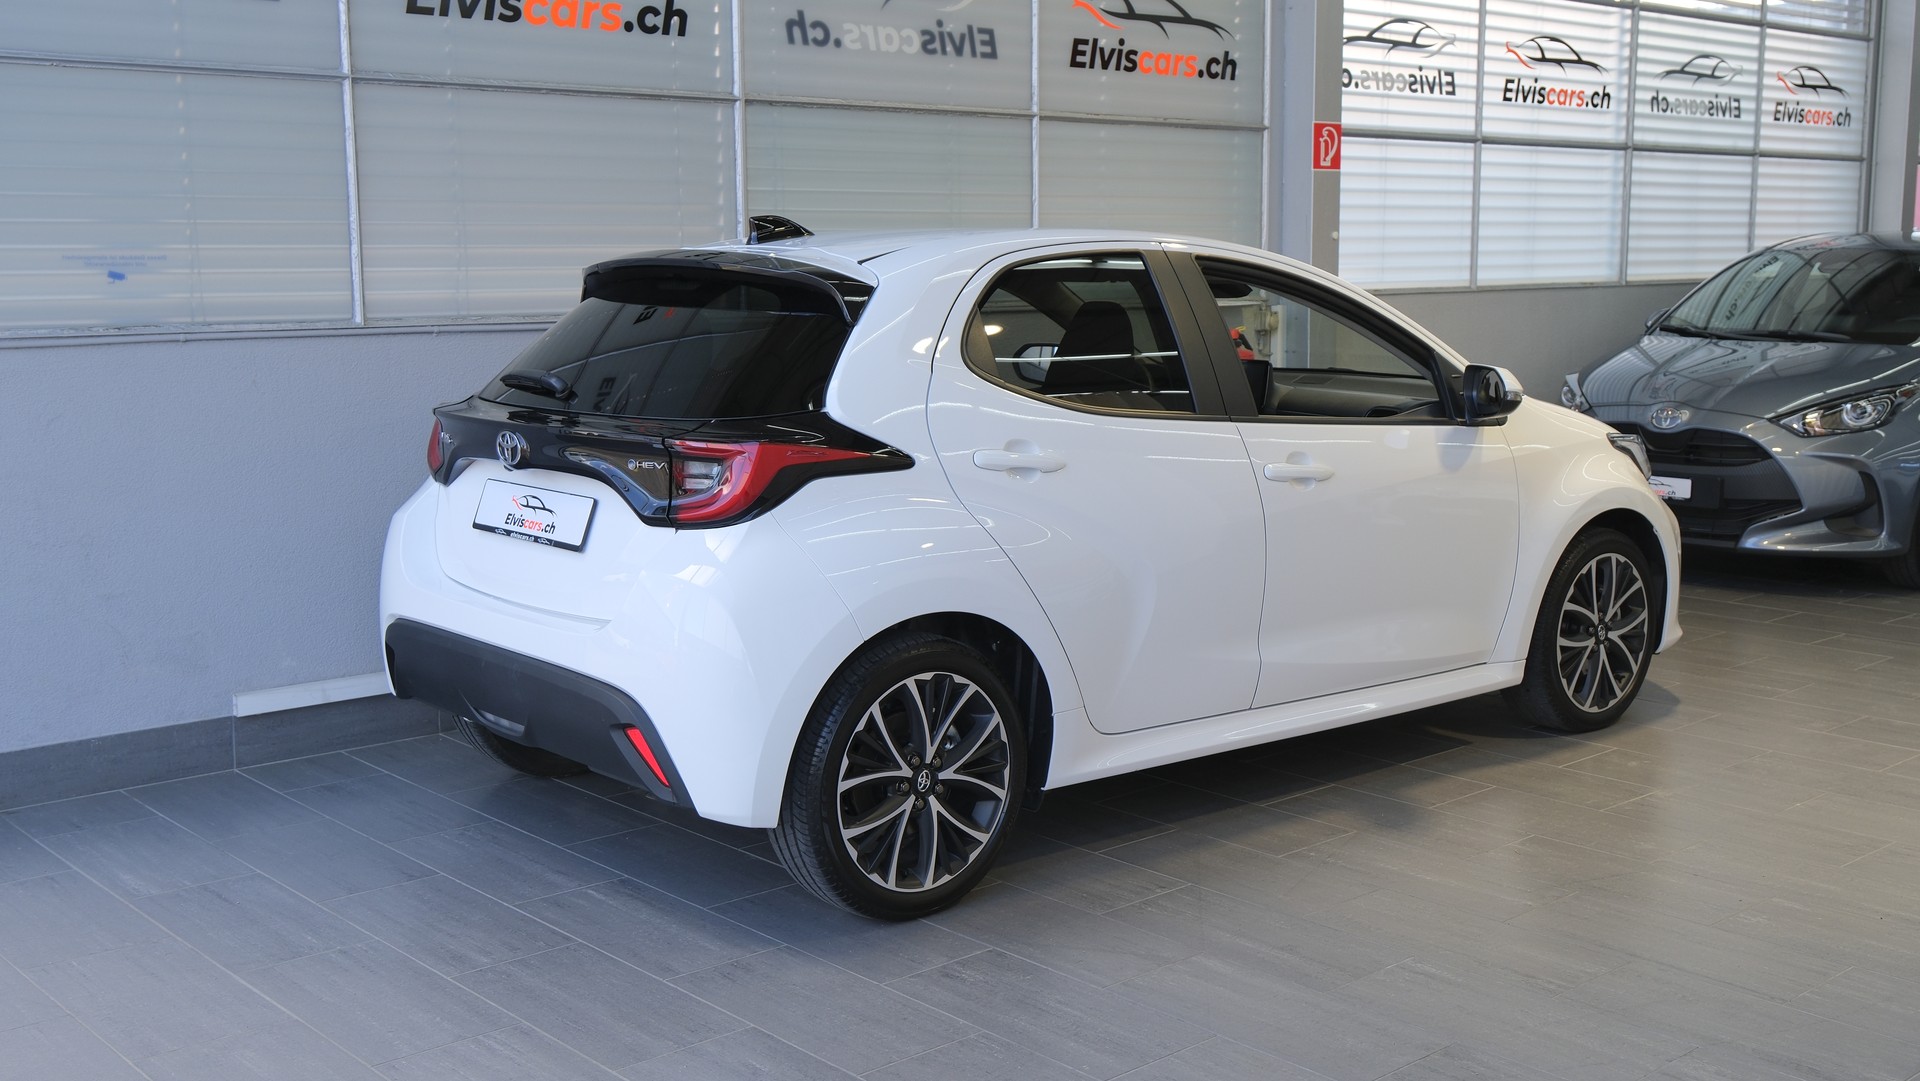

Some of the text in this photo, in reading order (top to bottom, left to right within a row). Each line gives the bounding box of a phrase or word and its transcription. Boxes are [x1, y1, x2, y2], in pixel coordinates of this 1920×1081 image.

[1069, 37, 1237, 81] Elviscars.ch
[1502, 77, 1611, 109] Elviscars.ch
[1773, 101, 1851, 127] Elviscars.ch
[504, 512, 556, 535] Elviscars.ch
